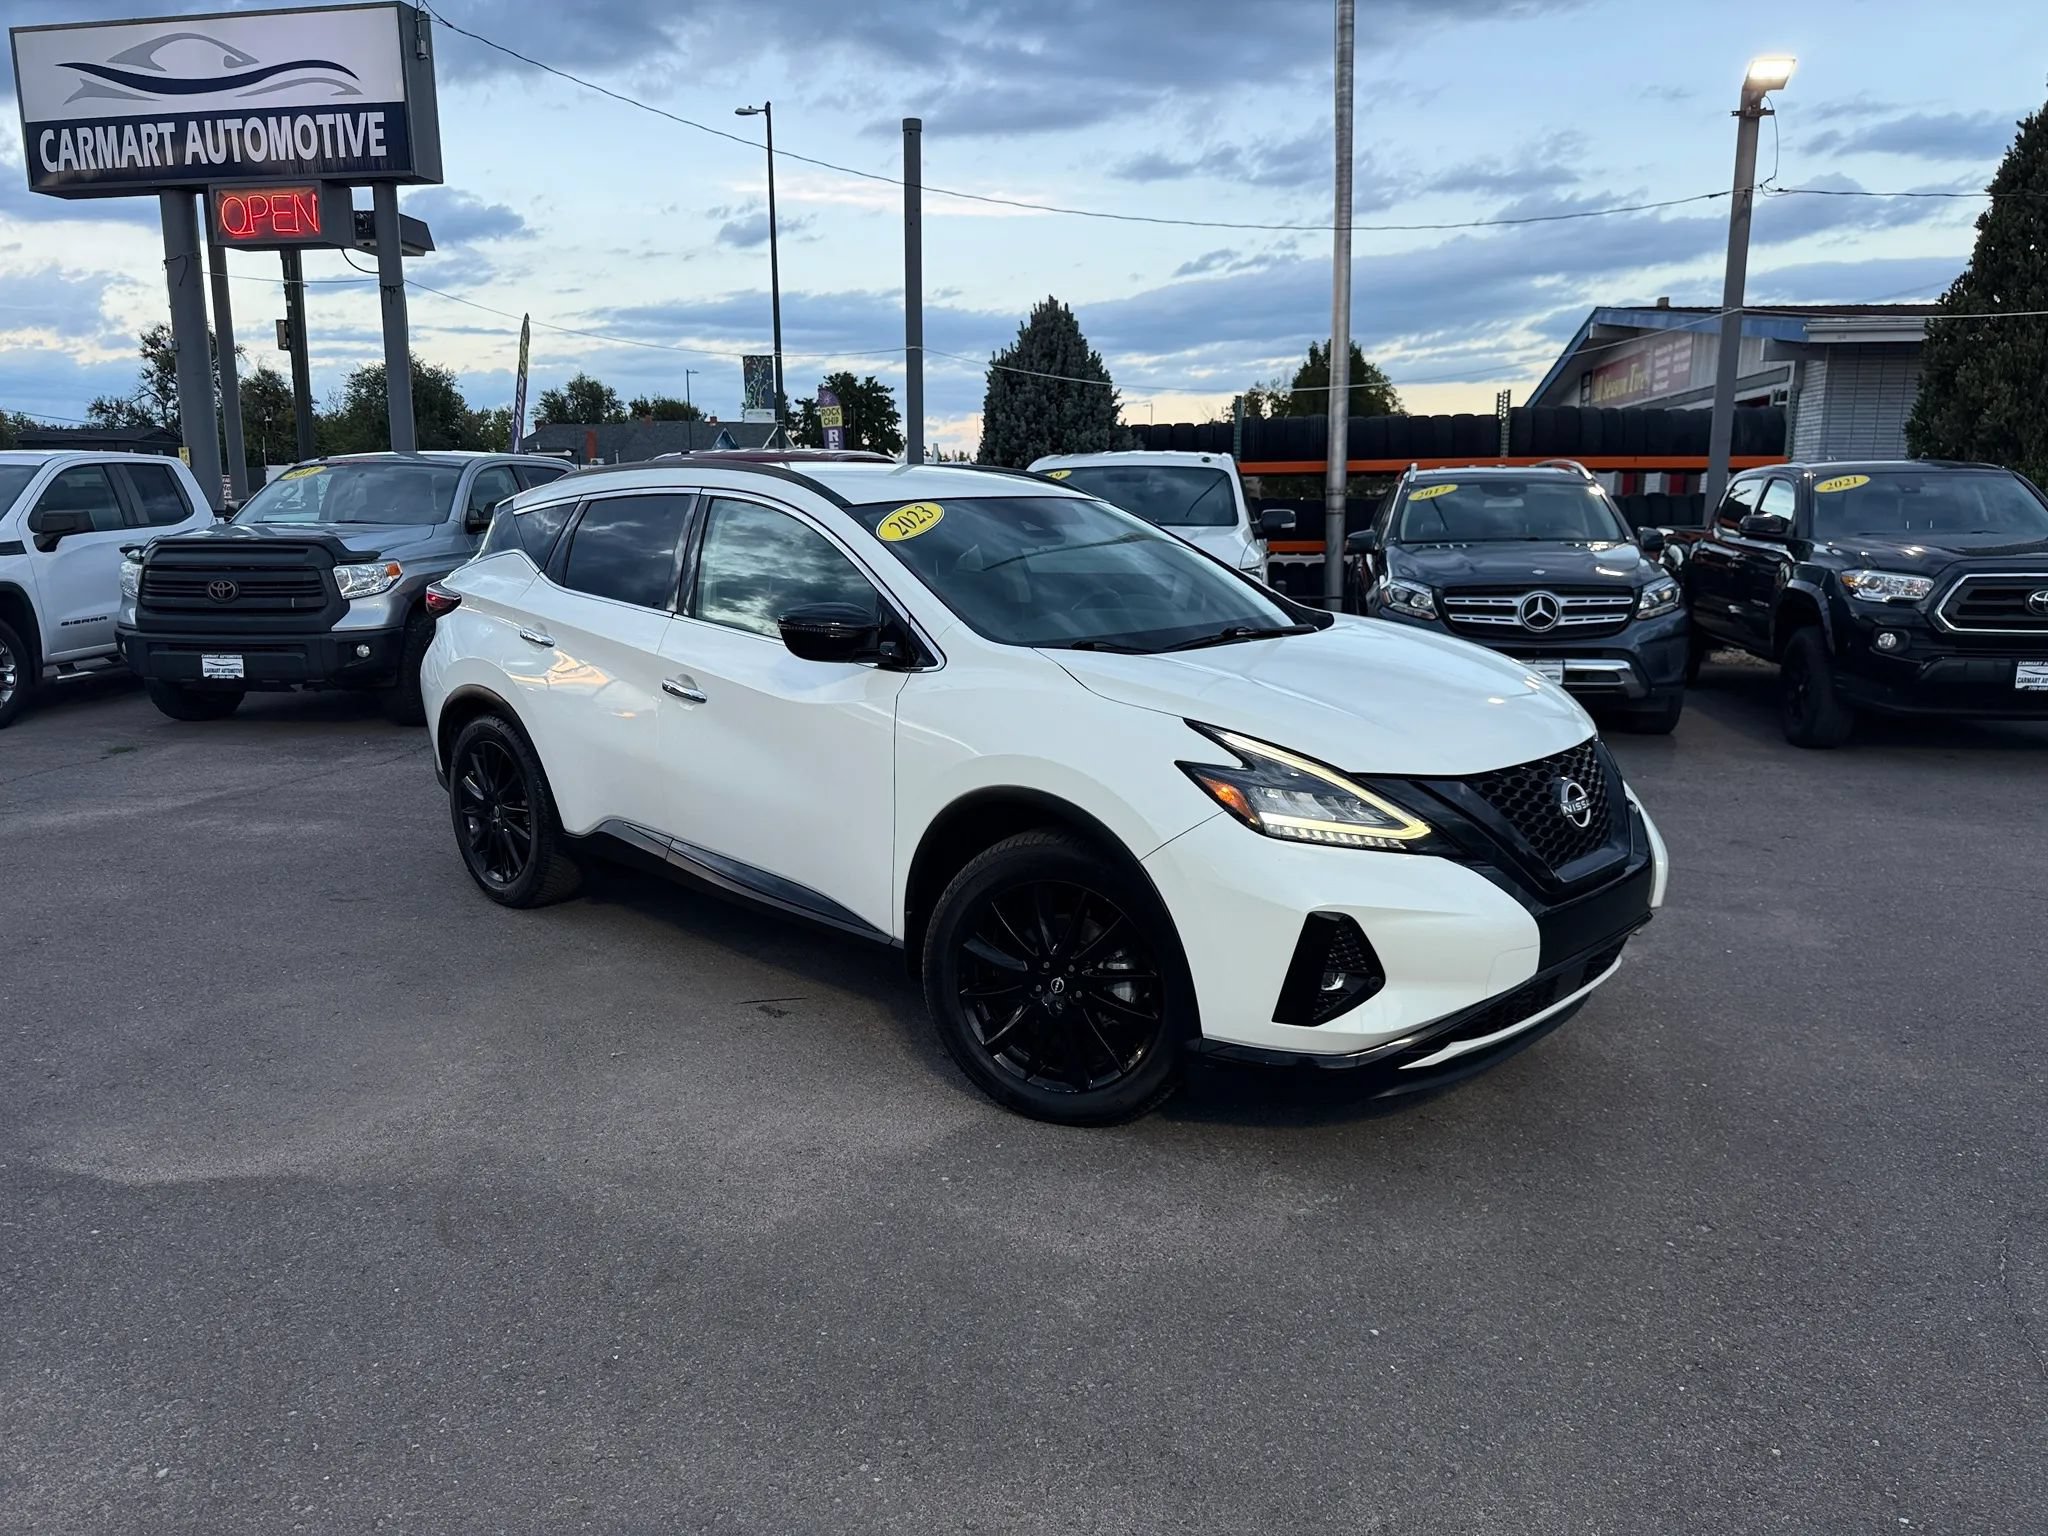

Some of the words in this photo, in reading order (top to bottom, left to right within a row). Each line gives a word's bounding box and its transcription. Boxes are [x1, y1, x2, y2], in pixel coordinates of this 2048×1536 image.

[40, 121, 176, 173] CARMART
[184, 111, 388, 166] AUTOMOTIVE
[221, 193, 320, 235] OPEN
[821, 407, 841, 418] ROCK
[823, 417, 840, 427] CHIP
[1826, 476, 1857, 490] 2021
[888, 505, 934, 537] 2023
[60, 615, 108, 626] SIERRA
